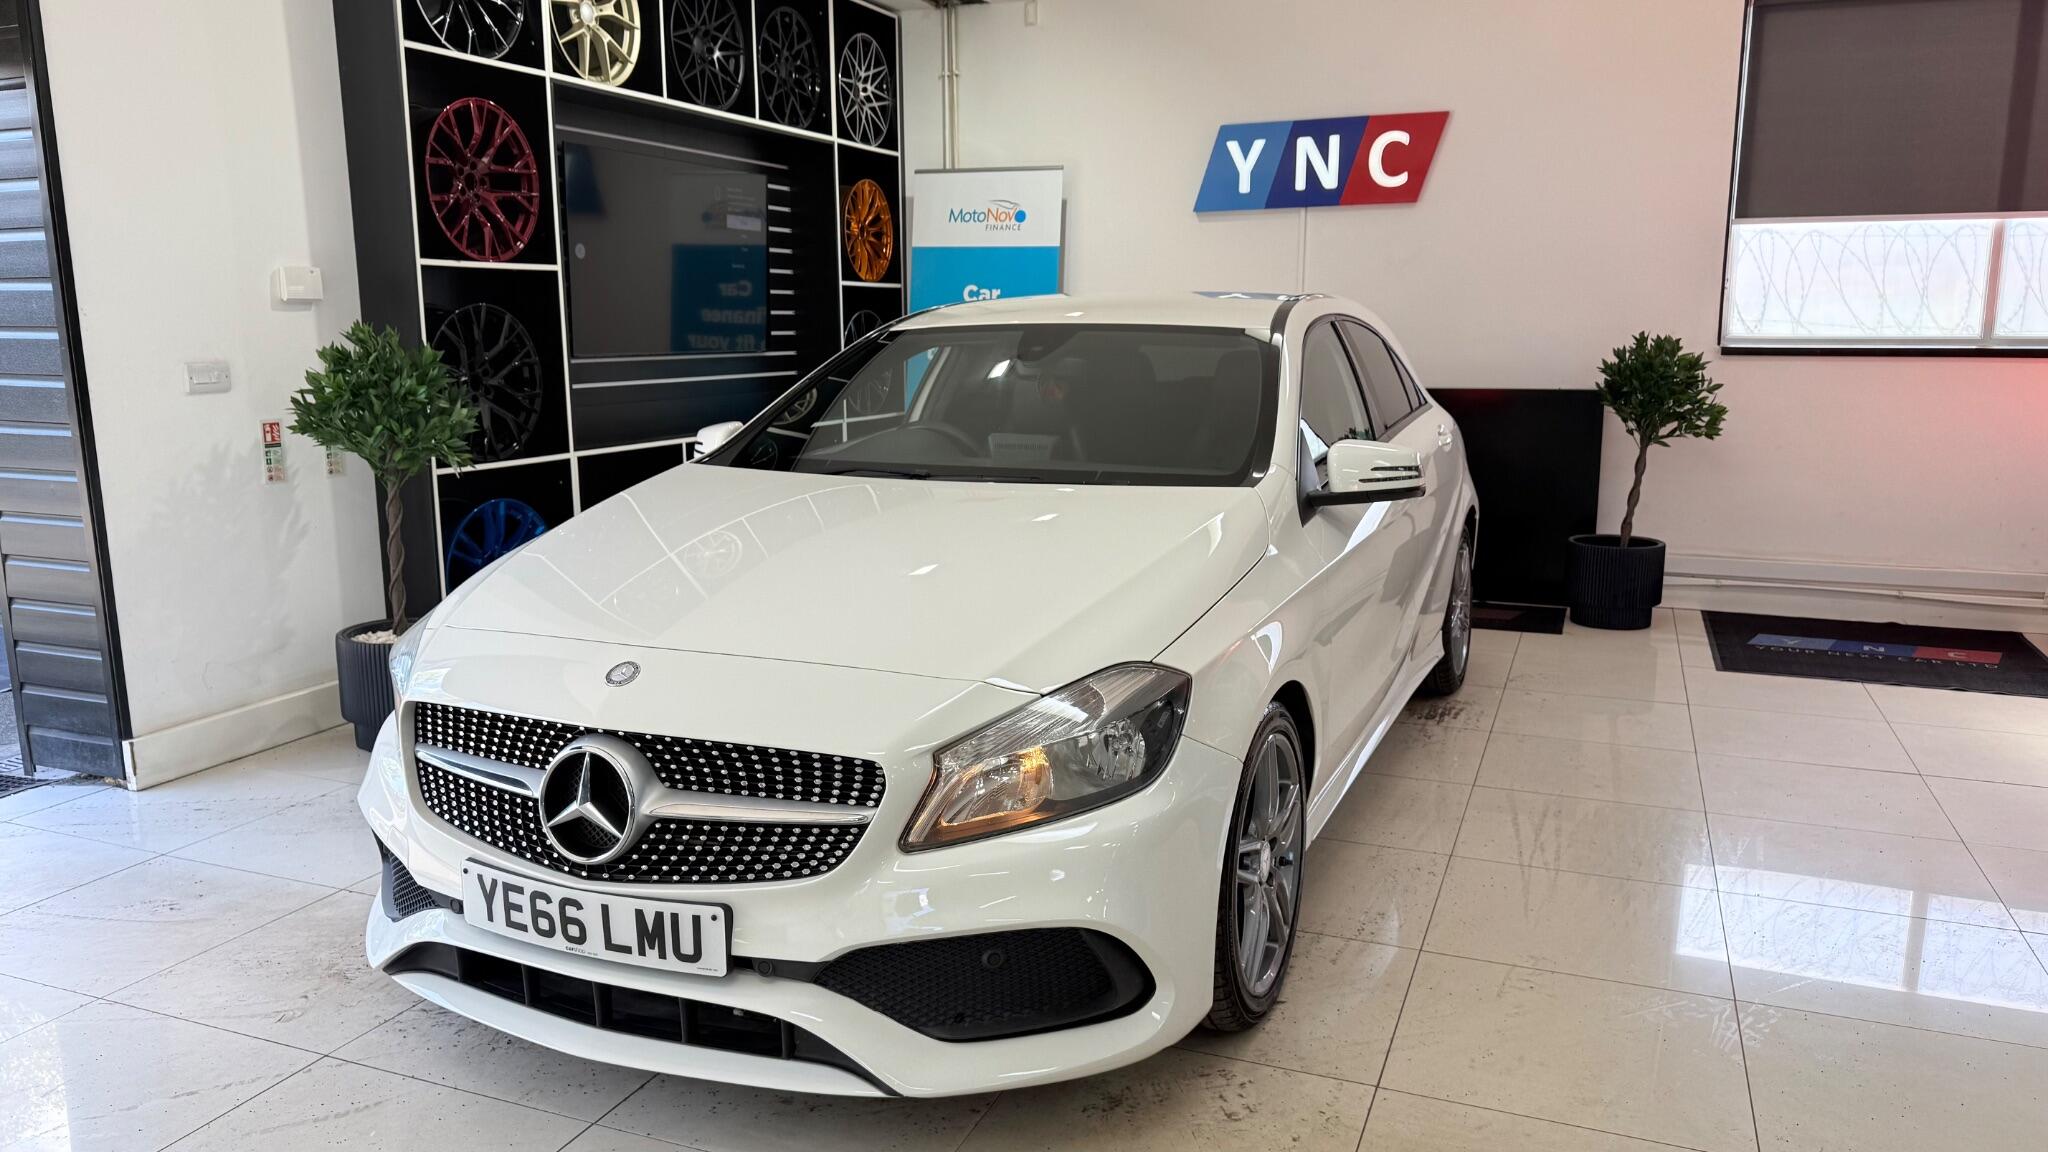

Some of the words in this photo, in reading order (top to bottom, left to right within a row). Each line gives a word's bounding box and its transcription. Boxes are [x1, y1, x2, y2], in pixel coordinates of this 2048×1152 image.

[1226, 130, 1410, 194] YNC
[985, 223, 1022, 231] FINANCE
[963, 284, 1001, 301] Car
[1827, 651, 1885, 660] NEXT
[1898, 656, 1944, 664] CAR
[477, 873, 588, 946] YE66
[601, 903, 702, 963] LMU
